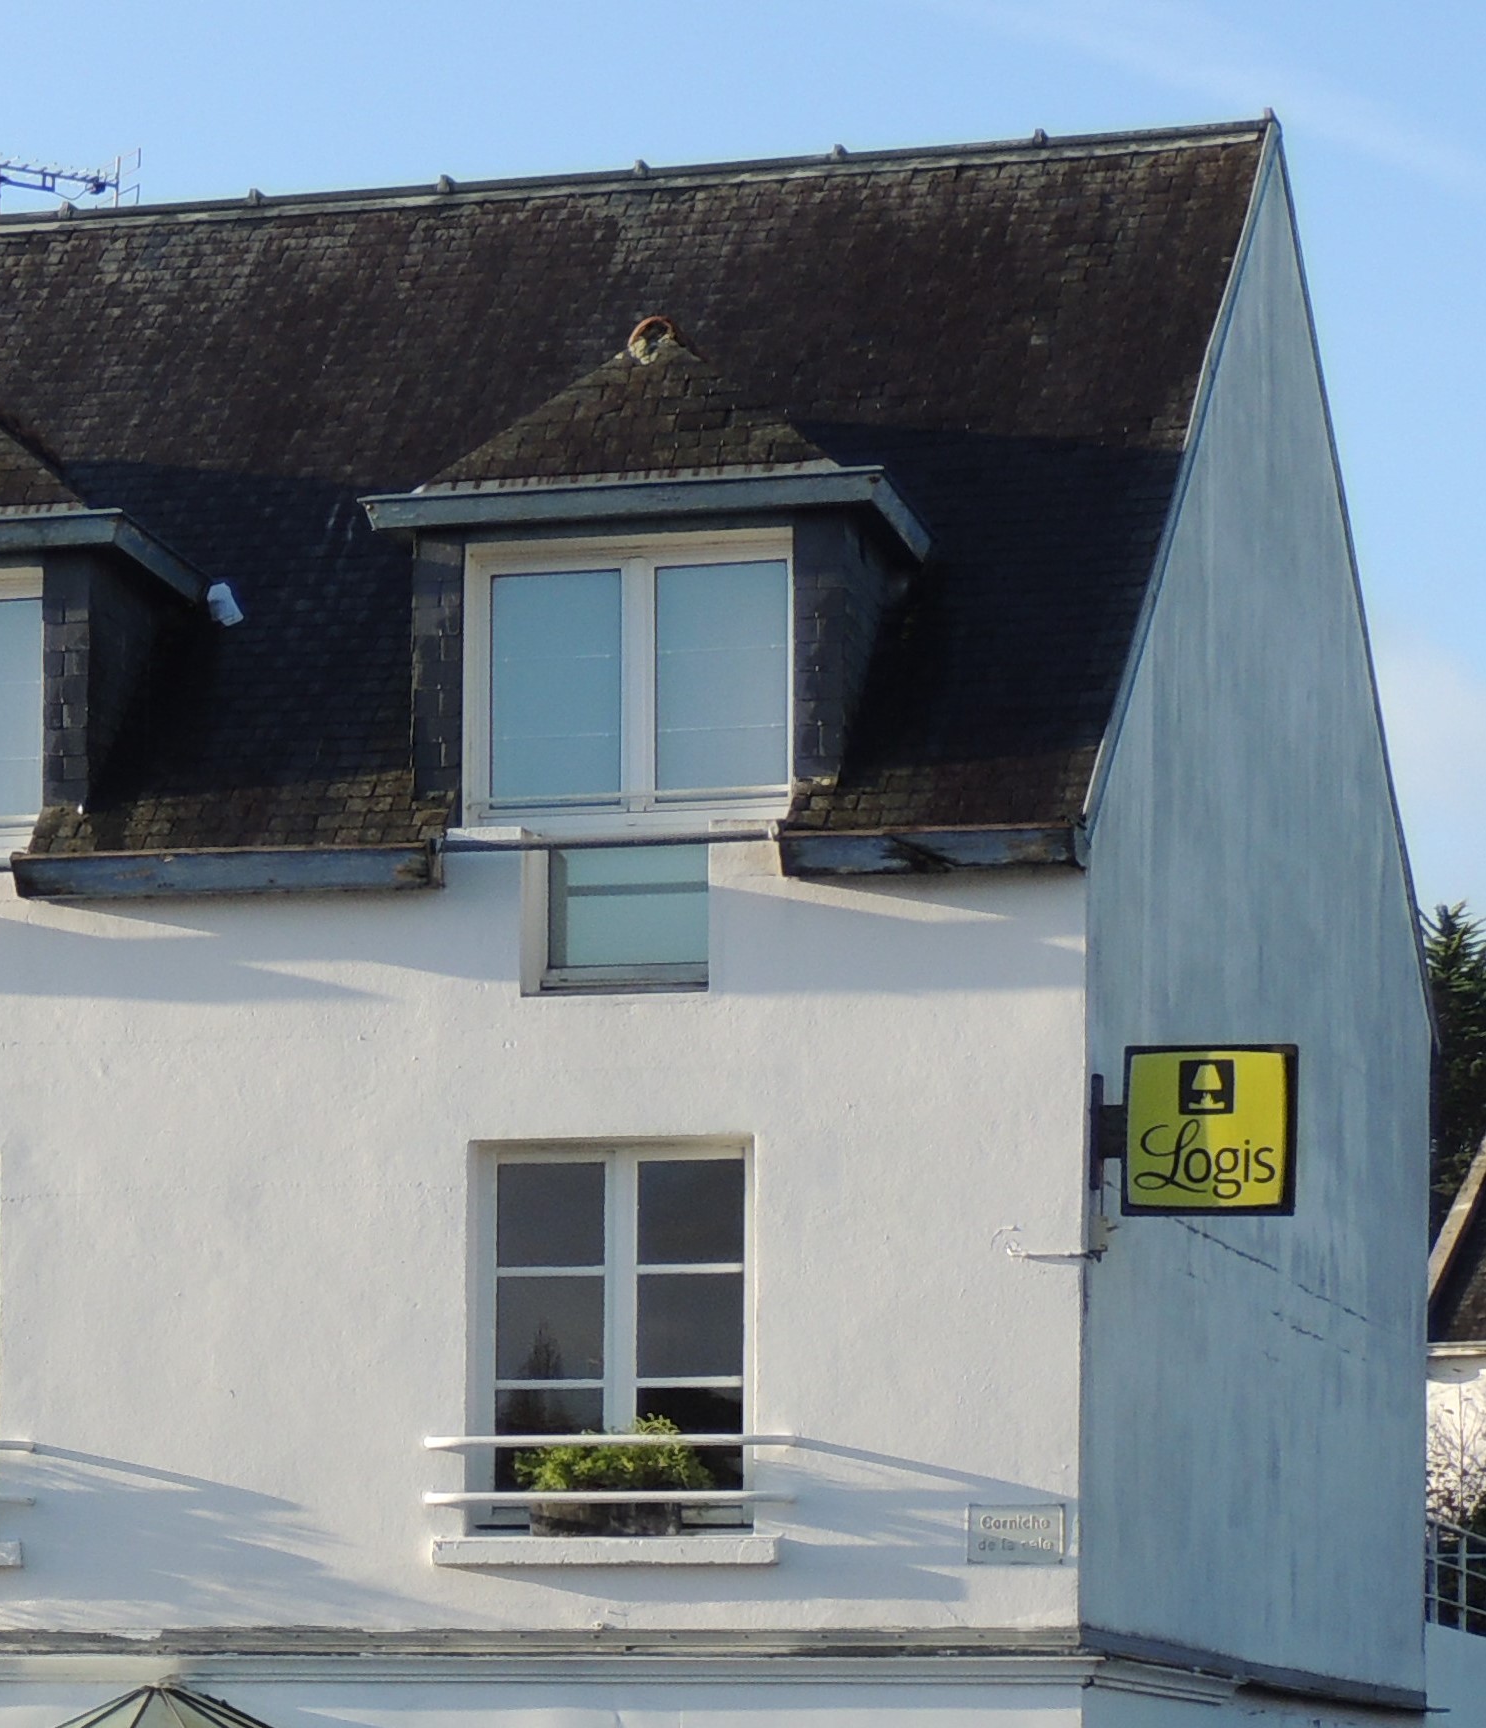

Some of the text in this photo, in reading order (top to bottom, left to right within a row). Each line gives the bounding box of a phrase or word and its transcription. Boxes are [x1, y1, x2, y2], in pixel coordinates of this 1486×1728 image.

[1134, 1119, 1275, 1199] Logis
[980, 1515, 1050, 1529] Corniche
[979, 1540, 995, 1550] de
[1002, 1538, 1014, 1551] la
